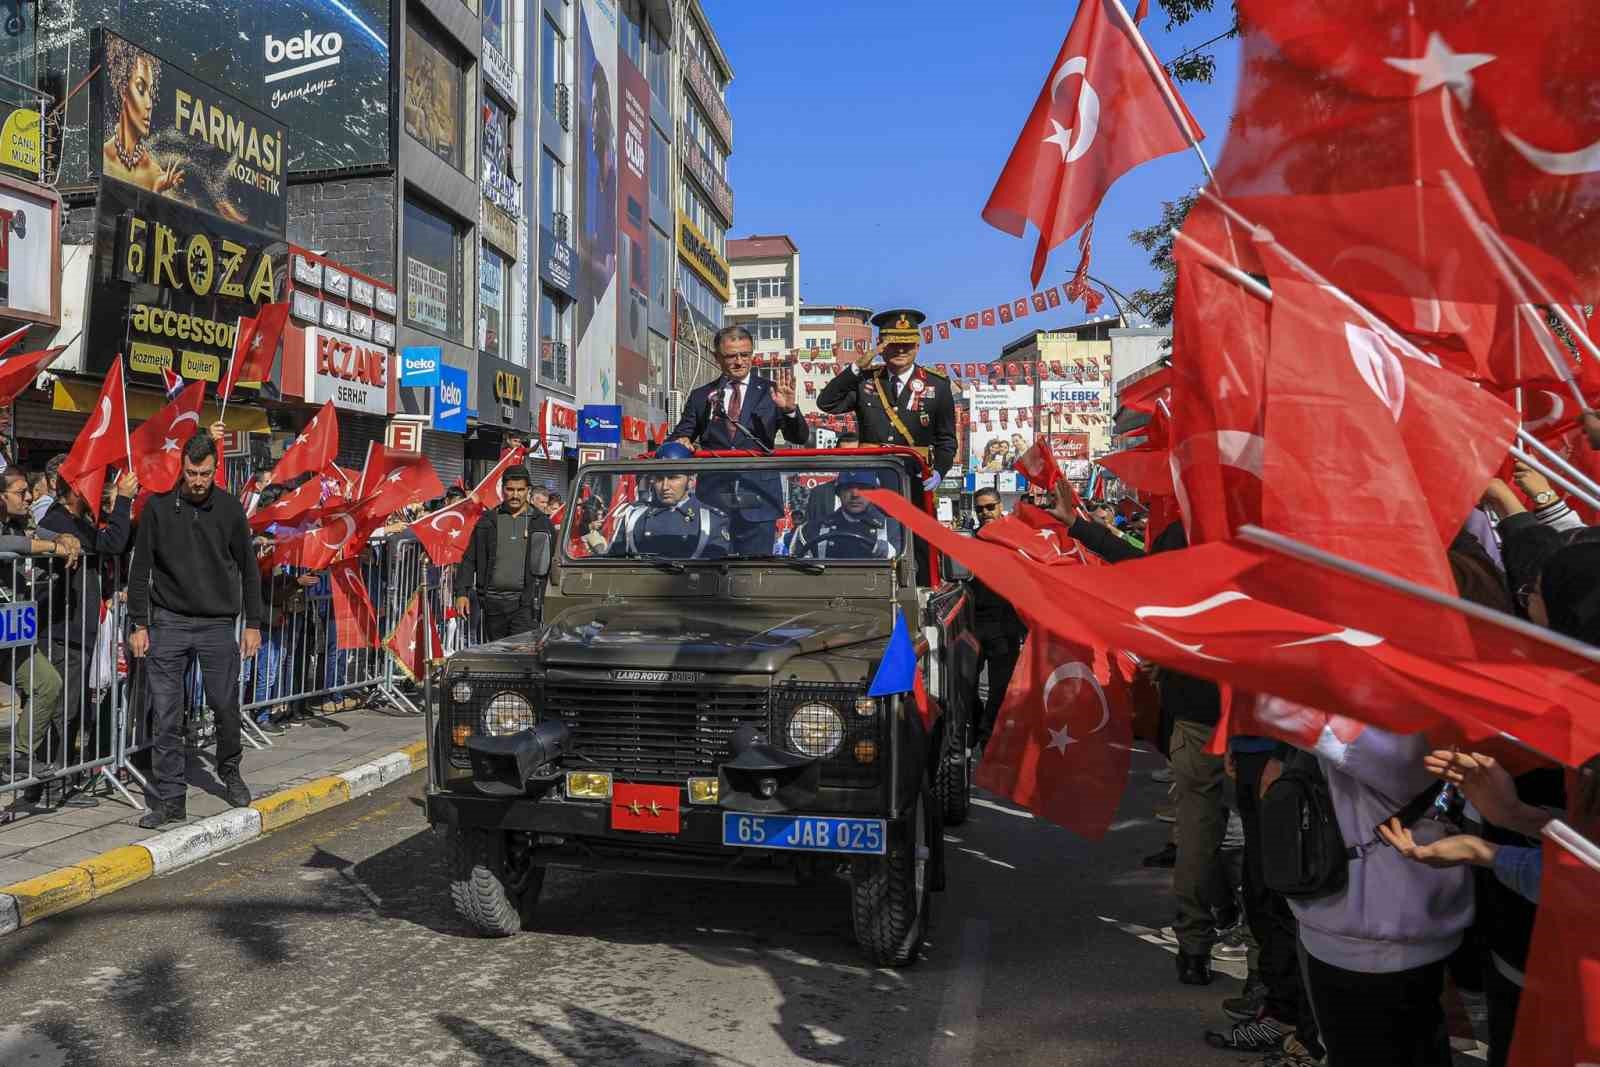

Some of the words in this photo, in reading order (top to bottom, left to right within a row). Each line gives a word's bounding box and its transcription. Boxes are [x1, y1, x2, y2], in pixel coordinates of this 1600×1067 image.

[265, 29, 342, 63] beko
[175, 88, 282, 176] FARMASİ
[153, 221, 276, 304] ROZA
[133, 349, 171, 367] kozmetik
[317, 334, 386, 389] ECZANE
[406, 358, 435, 369] beko
[337, 386, 368, 406] SERHAT
[440, 379, 462, 405] beko
[1051, 391, 1100, 401] KELEBEK
[616, 671, 640, 681] LAND
[640, 672, 670, 681] ROVER
[738, 816, 765, 842] 65
[787, 817, 830, 848] JAB
[837, 822, 881, 849] 025
